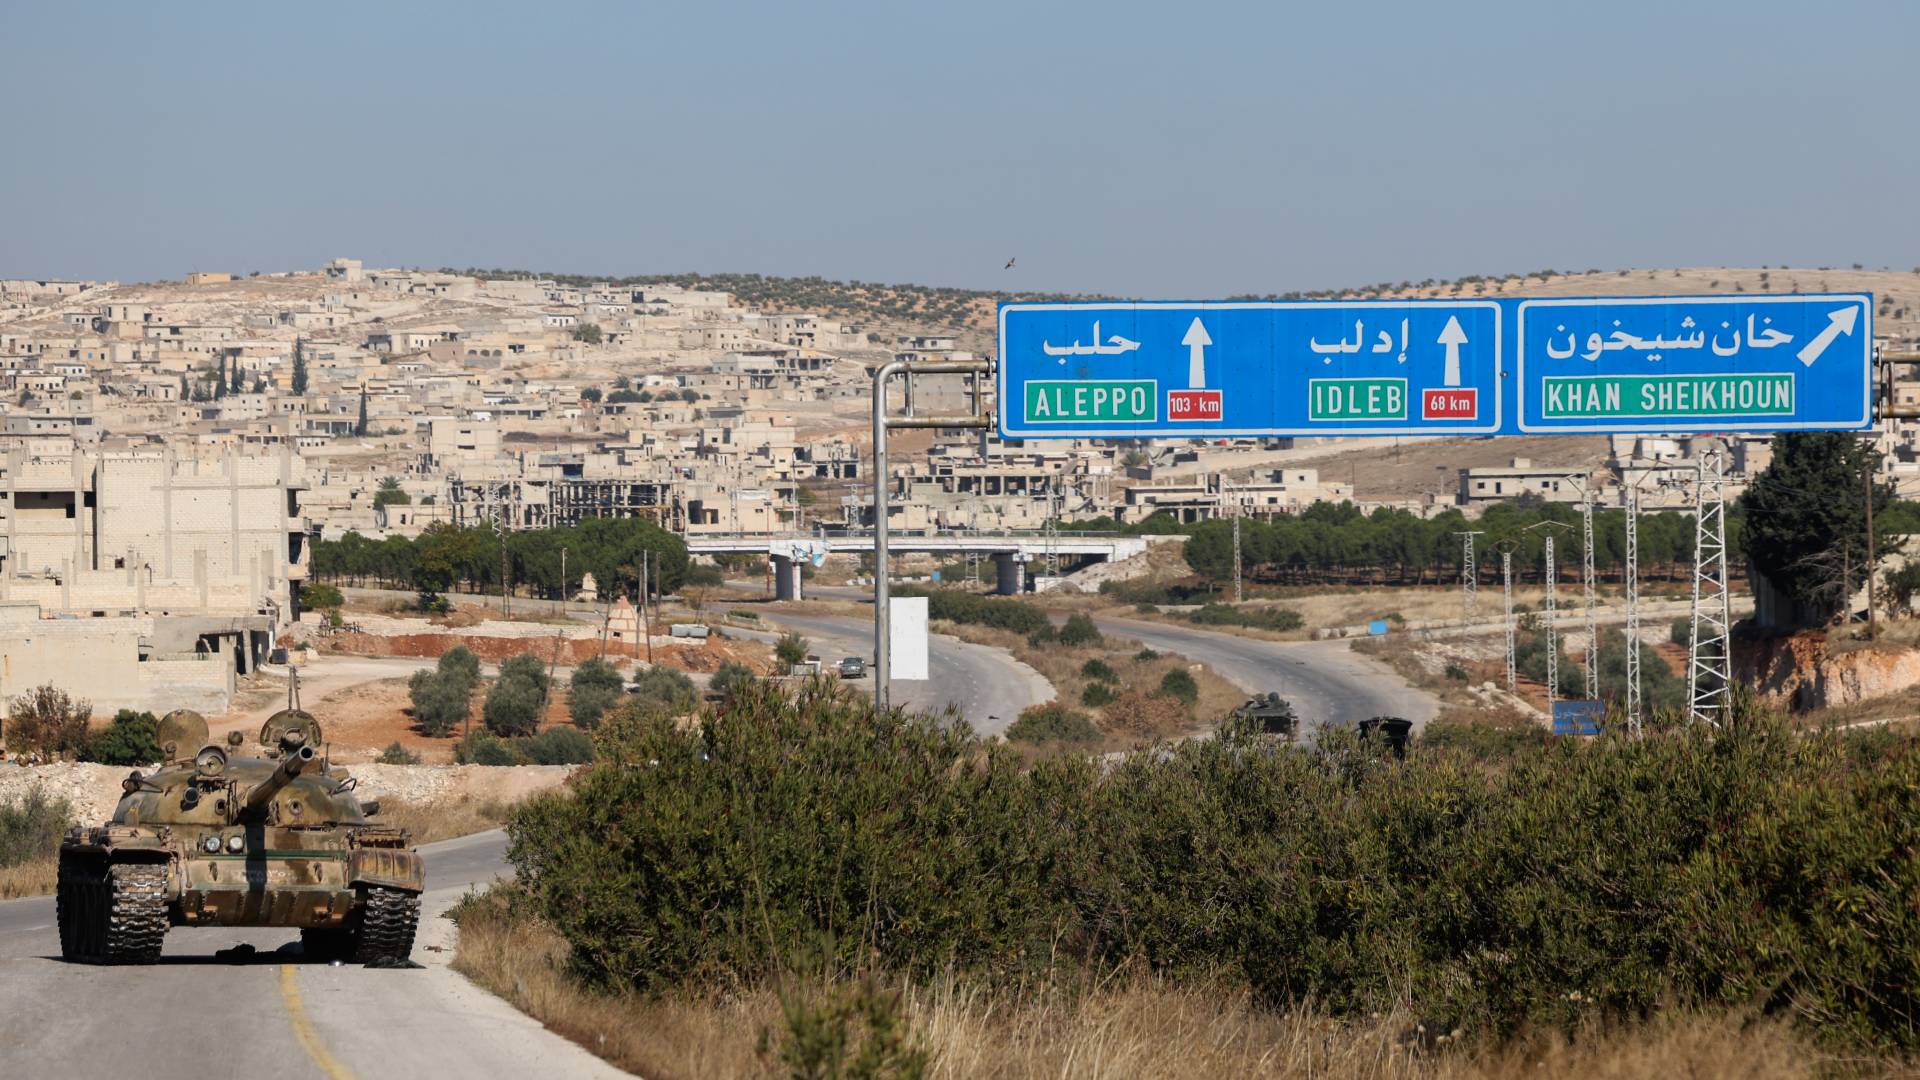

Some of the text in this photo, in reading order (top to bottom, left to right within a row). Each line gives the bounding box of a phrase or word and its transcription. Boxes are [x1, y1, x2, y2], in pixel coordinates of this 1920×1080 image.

[1043, 319, 1141, 365] حلب
[1310, 318, 1409, 364] إدلب
[1546, 313, 1795, 362] خان شيخون
[1035, 386, 1146, 417] ALEPPO
[1170, 397, 1220, 413] 103 km
[1316, 385, 1402, 414] IDLEB
[1430, 395, 1470, 411] 68 km
[1548, 380, 1791, 413] KHAN SHEIKHOUN
